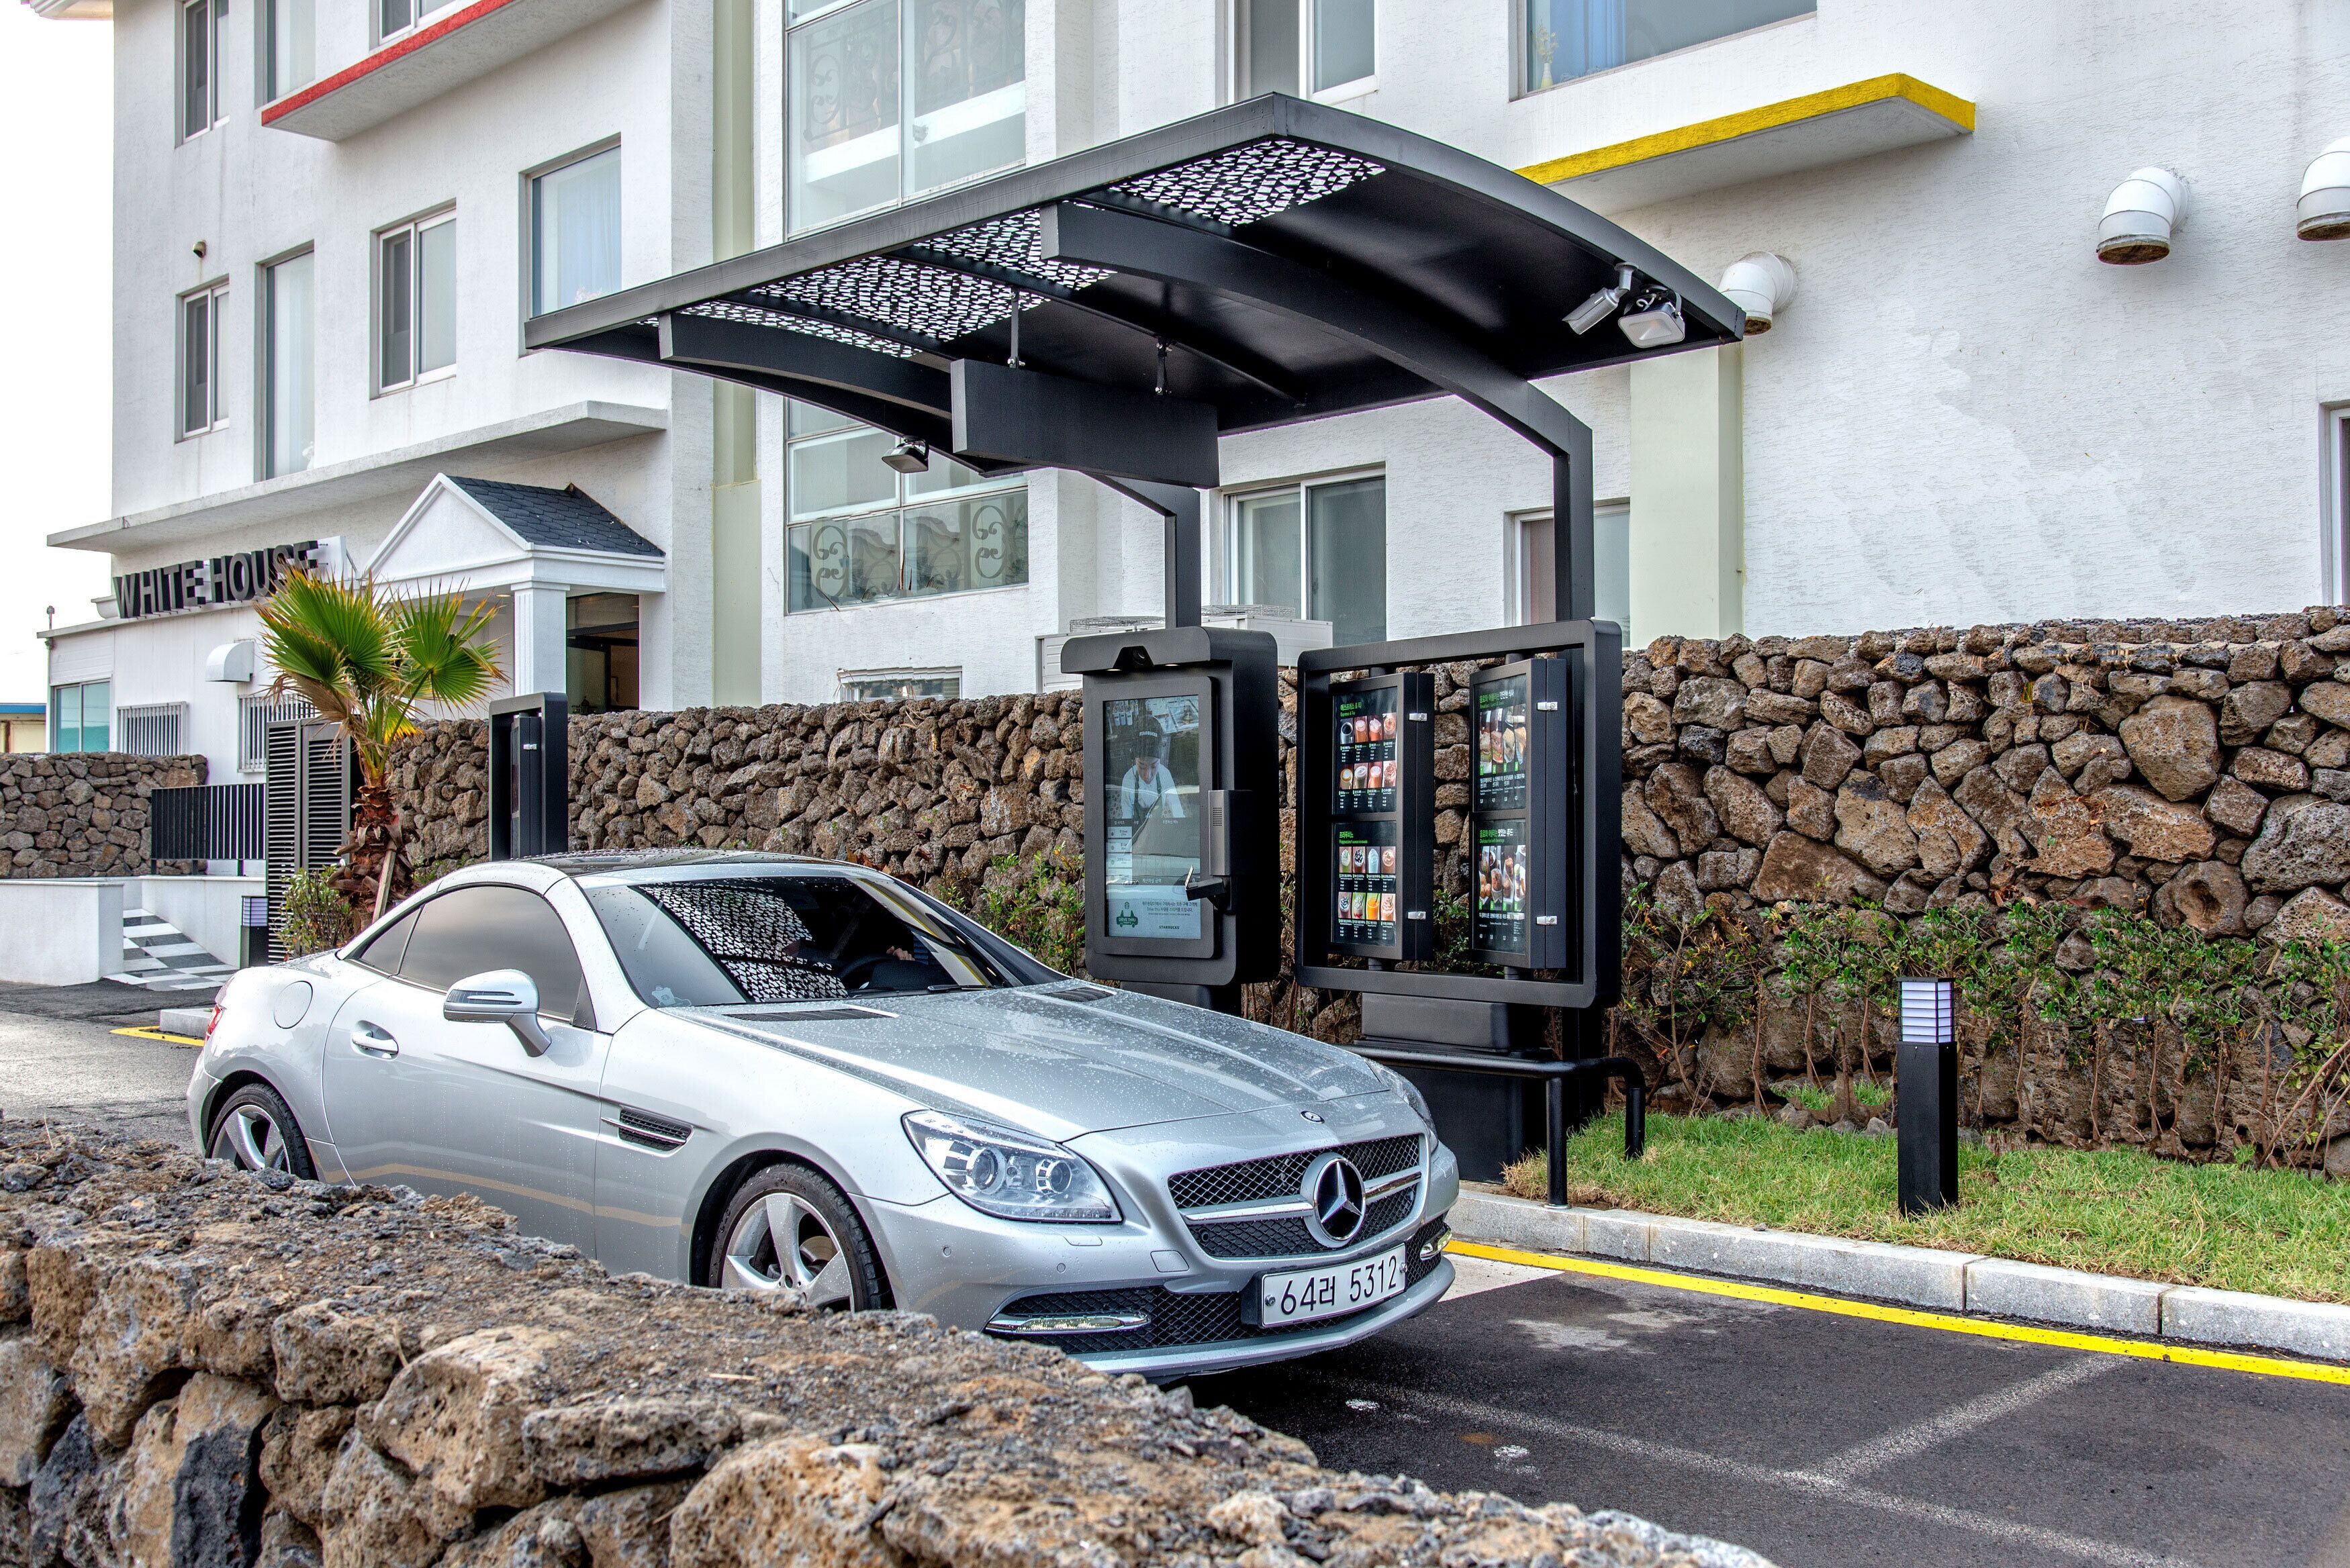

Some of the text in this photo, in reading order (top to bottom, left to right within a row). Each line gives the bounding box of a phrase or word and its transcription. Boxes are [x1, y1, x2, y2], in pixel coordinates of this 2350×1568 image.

[113, 560, 205, 619] WHITE
[1280, 1255, 1397, 1315] 64러 5312
